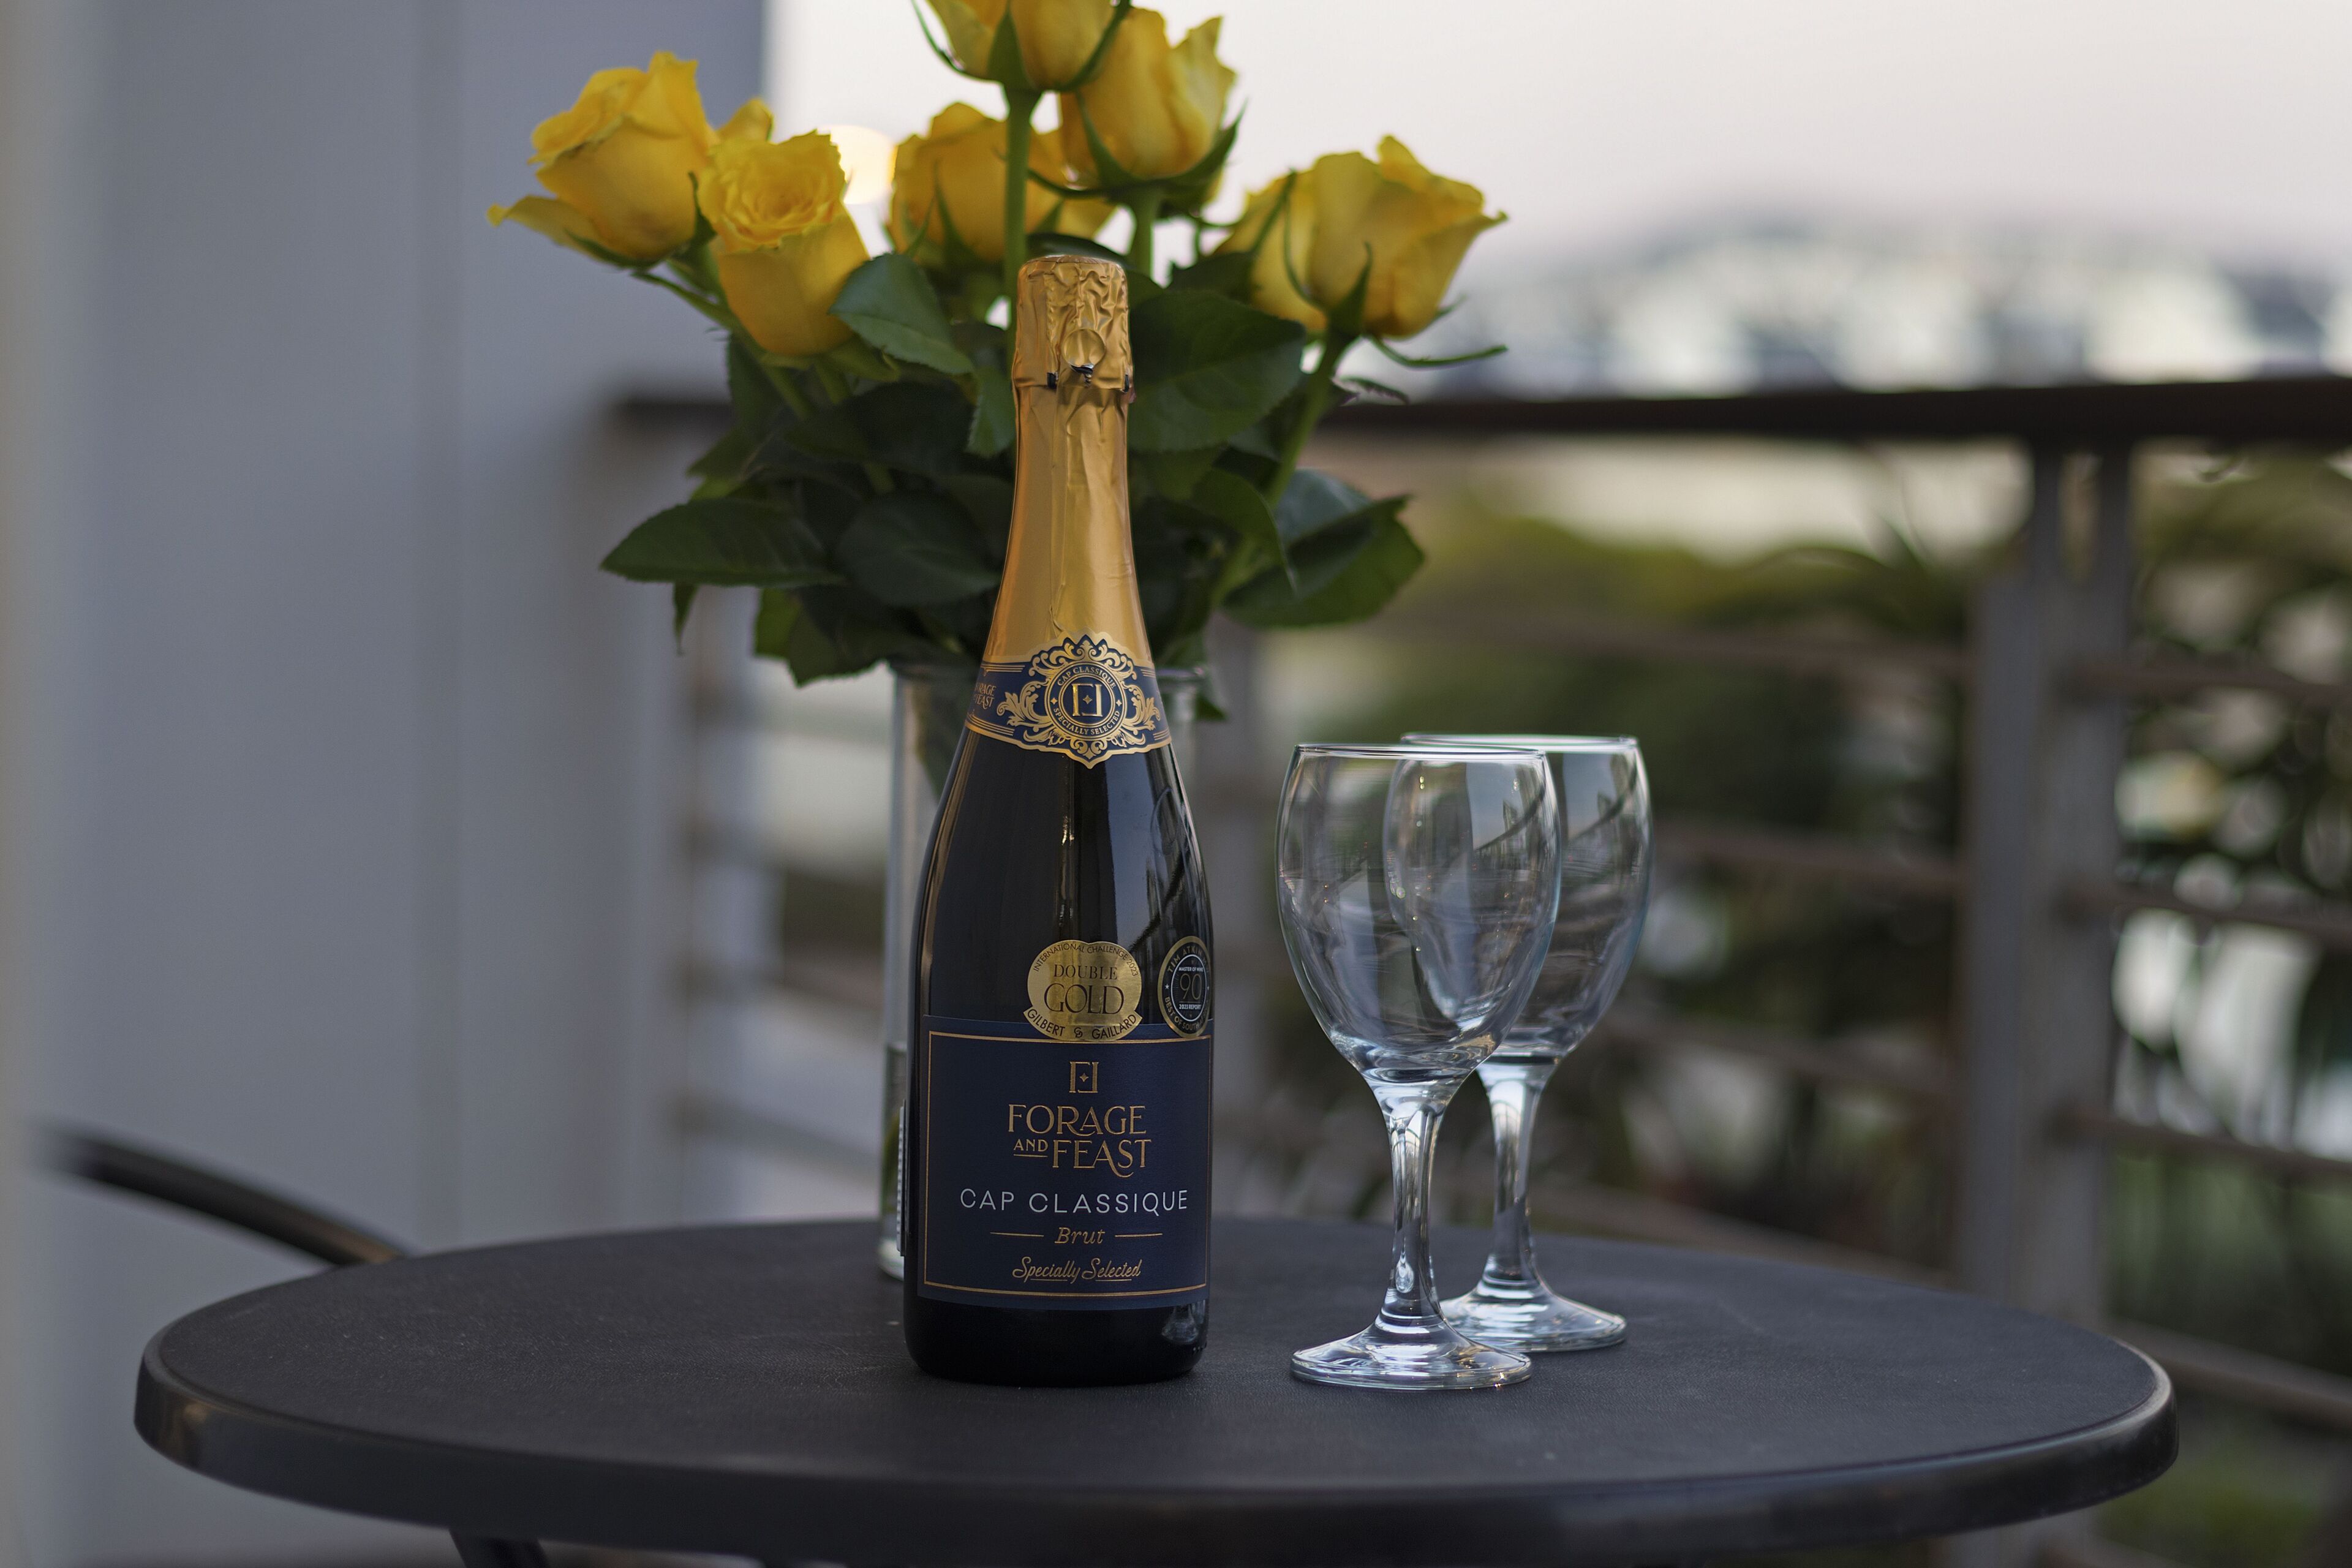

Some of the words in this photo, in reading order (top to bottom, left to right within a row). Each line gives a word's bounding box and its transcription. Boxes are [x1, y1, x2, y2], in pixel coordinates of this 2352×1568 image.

[975, 682, 997, 696] RAGE
[1057, 672, 1071, 686] CAP
[1073, 666, 1115, 689] CLASSIQUE
[1054, 708, 1088, 734] SPECIALLY
[1091, 710, 1120, 734] SELECTED
[1033, 943, 1084, 972] INTERNATIONAL
[1087, 946, 1128, 960] CHALLENGE
[1126, 959, 1138, 976] 2023
[1054, 964, 1118, 980] DOUBLE
[1167, 955, 1180, 973] TIM
[1183, 946, 1202, 956] ATKIN
[1044, 983, 1124, 1014] GOLD
[1180, 973, 1202, 1000] 90
[1027, 1009, 1065, 1036] GILBERT
[1091, 1014, 1136, 1039] GAILLARD
[1165, 997, 1175, 1016] BEST
[1174, 1016, 1182, 1027] OF
[1008, 1104, 1147, 1136] FORAGE
[1014, 1139, 1049, 1152] AND
[1052, 1139, 1152, 1177] FEAST
[960, 1188, 1014, 1210] CAP
[1029, 1189, 1187, 1216] CLASSIQUE
[1055, 1227, 1106, 1244] Brut
[1012, 1256, 1081, 1284] Specially
[1082, 1257, 1142, 1279] Selected
